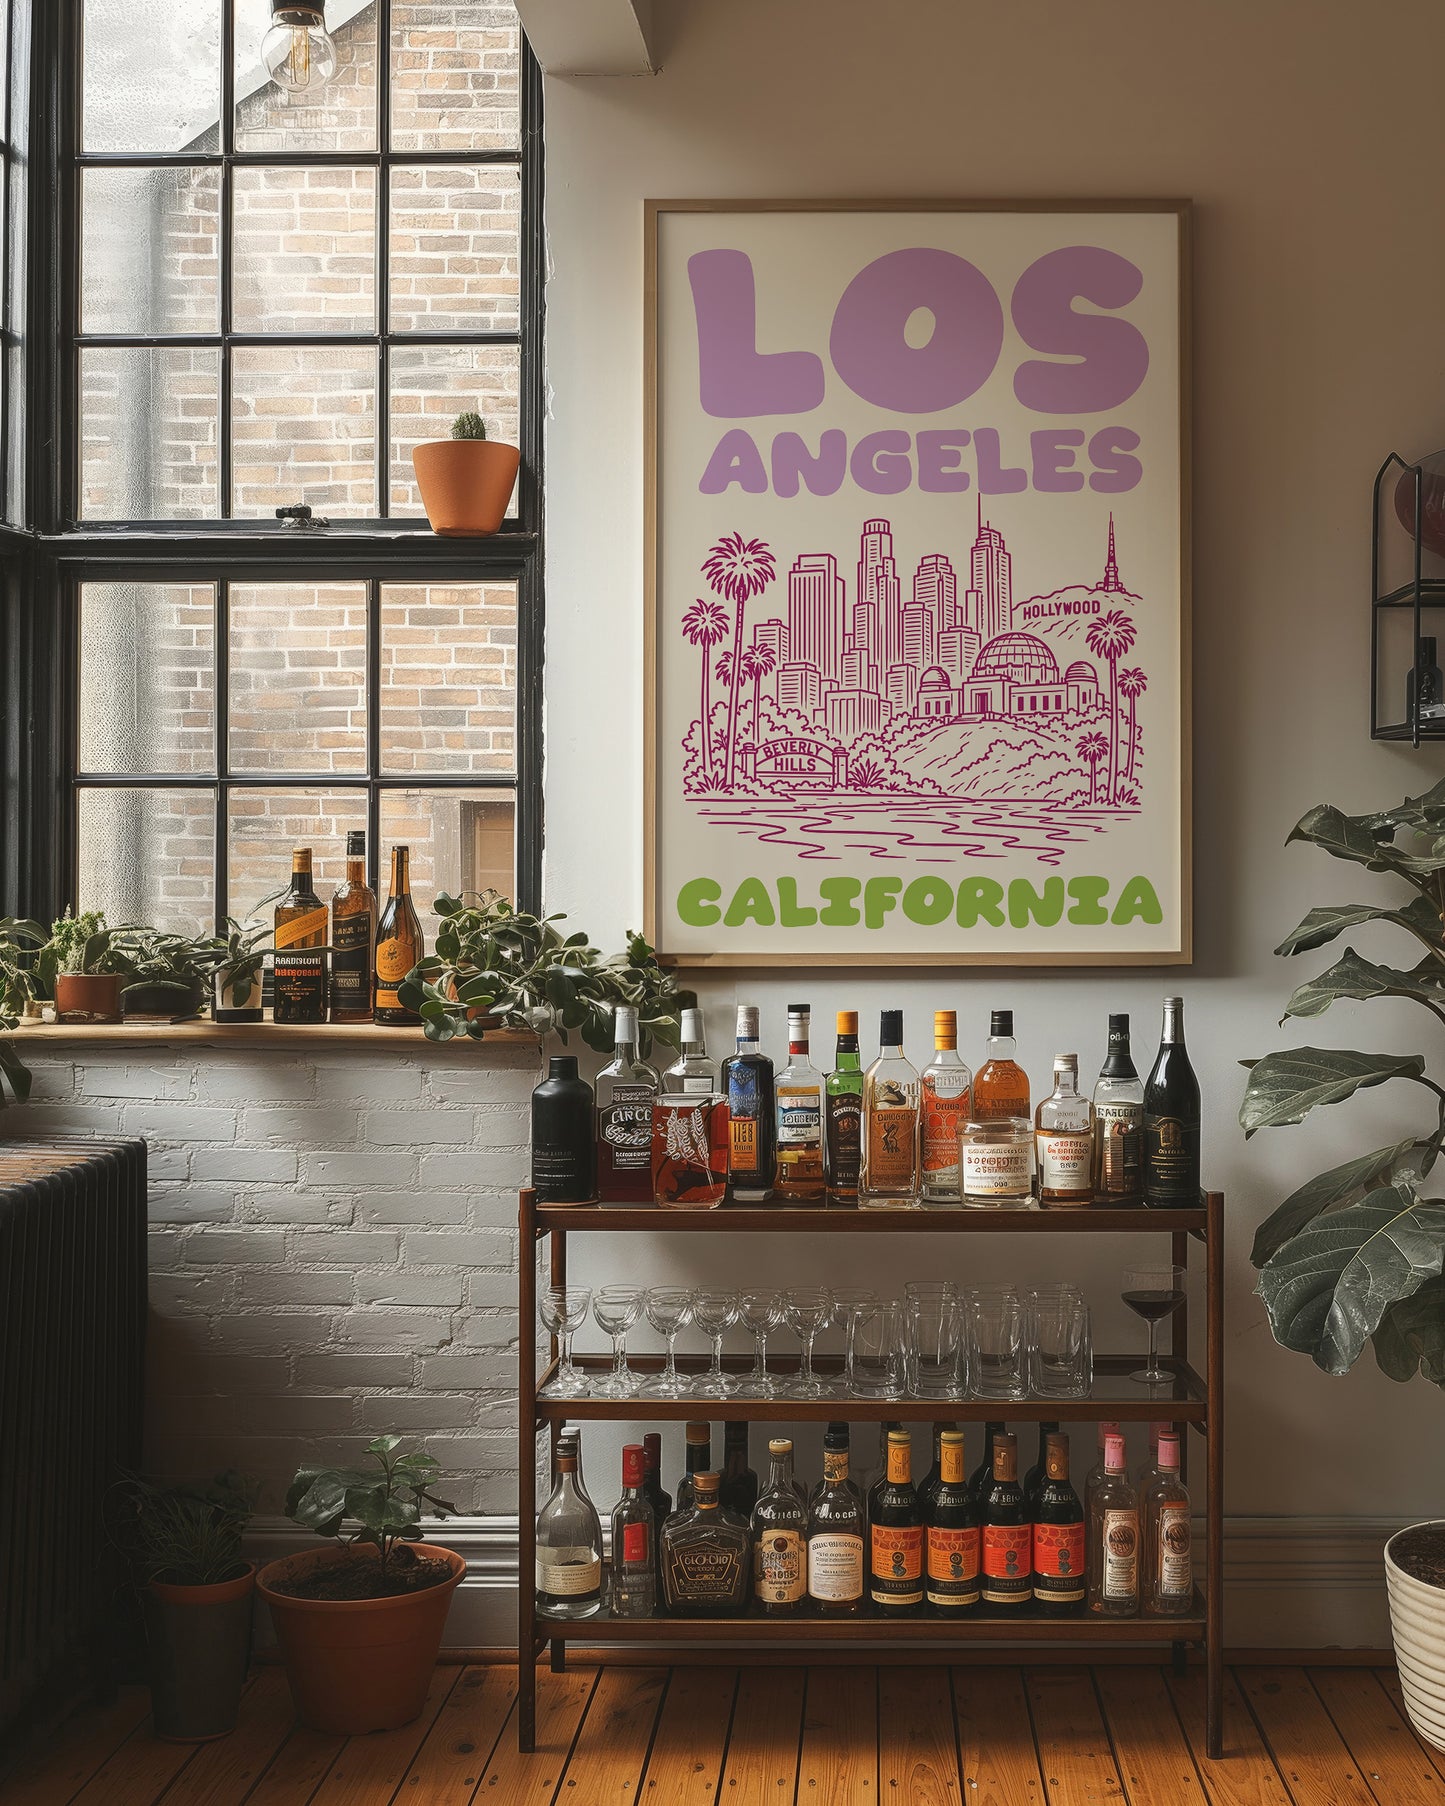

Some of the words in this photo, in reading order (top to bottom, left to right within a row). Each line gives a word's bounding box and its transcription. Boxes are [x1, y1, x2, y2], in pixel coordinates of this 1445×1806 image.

[687, 245, 1149, 419] LOS
[698, 426, 1143, 498] ANGELES
[1023, 600, 1100, 620] HOLLYWOOD
[763, 741, 823, 758] BEVERLY
[774, 758, 816, 771] HILLS
[677, 876, 1162, 928] CALIFORNIA
